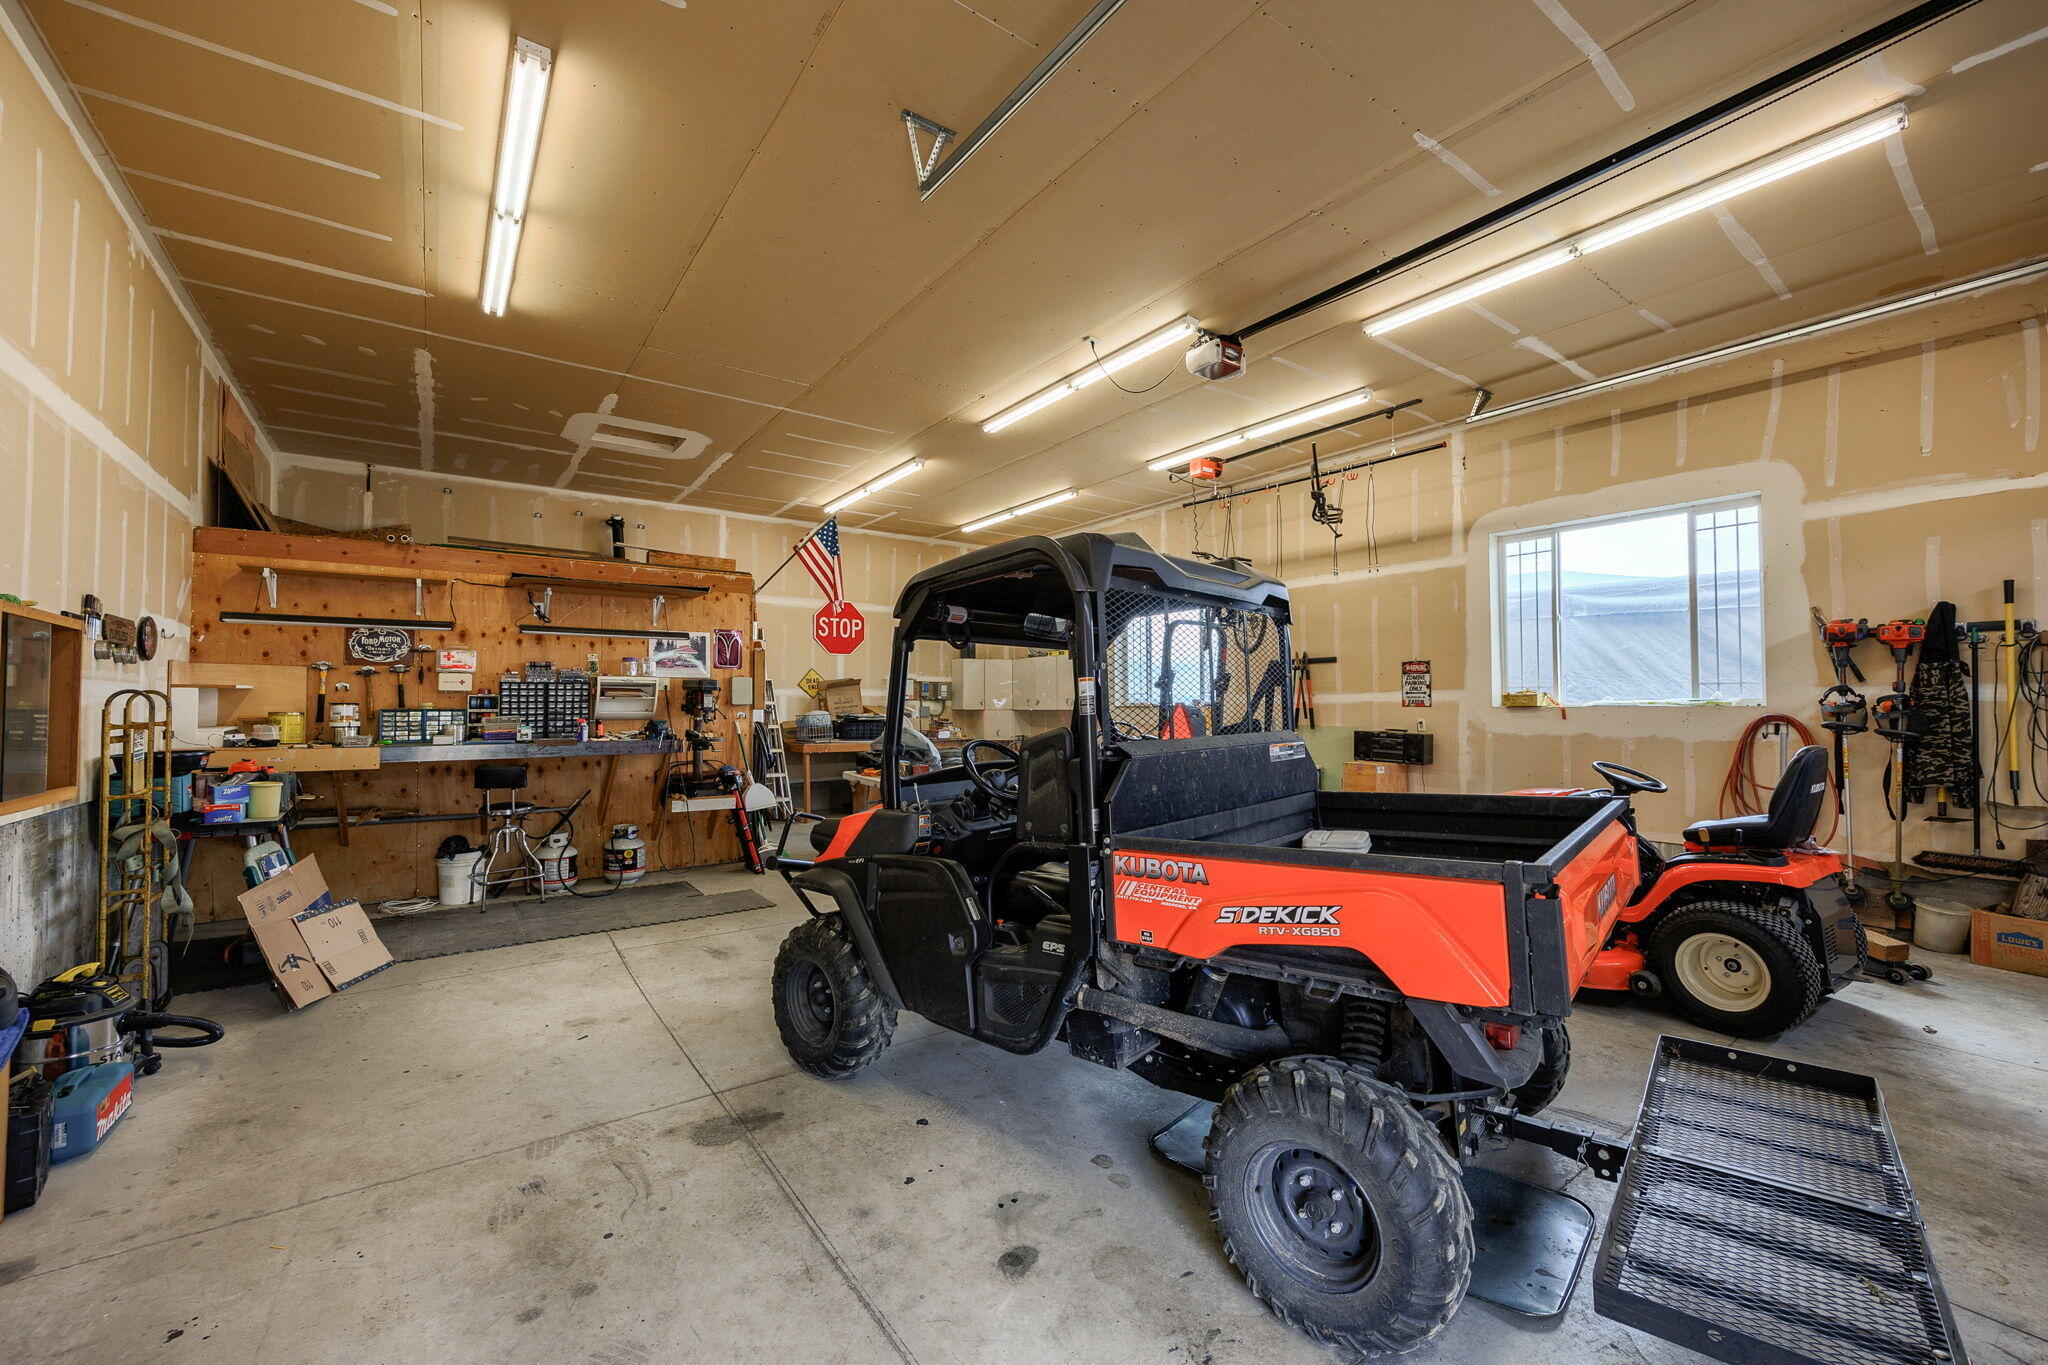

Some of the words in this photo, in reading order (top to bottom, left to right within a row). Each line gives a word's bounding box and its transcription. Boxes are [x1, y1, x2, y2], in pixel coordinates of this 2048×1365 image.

[818, 617, 862, 638] STOP
[361, 636, 380, 647] FORD
[223, 786, 242, 795] Ziploc
[1114, 855, 1210, 886] KUBOTA
[1137, 882, 1187, 895] CENTRAL
[1133, 889, 1203, 906] EQUIPMENT
[1215, 906, 1342, 924] SIDEKICK
[1258, 926, 1341, 936] RTV-XG850
[1042, 941, 1065, 952] EPS
